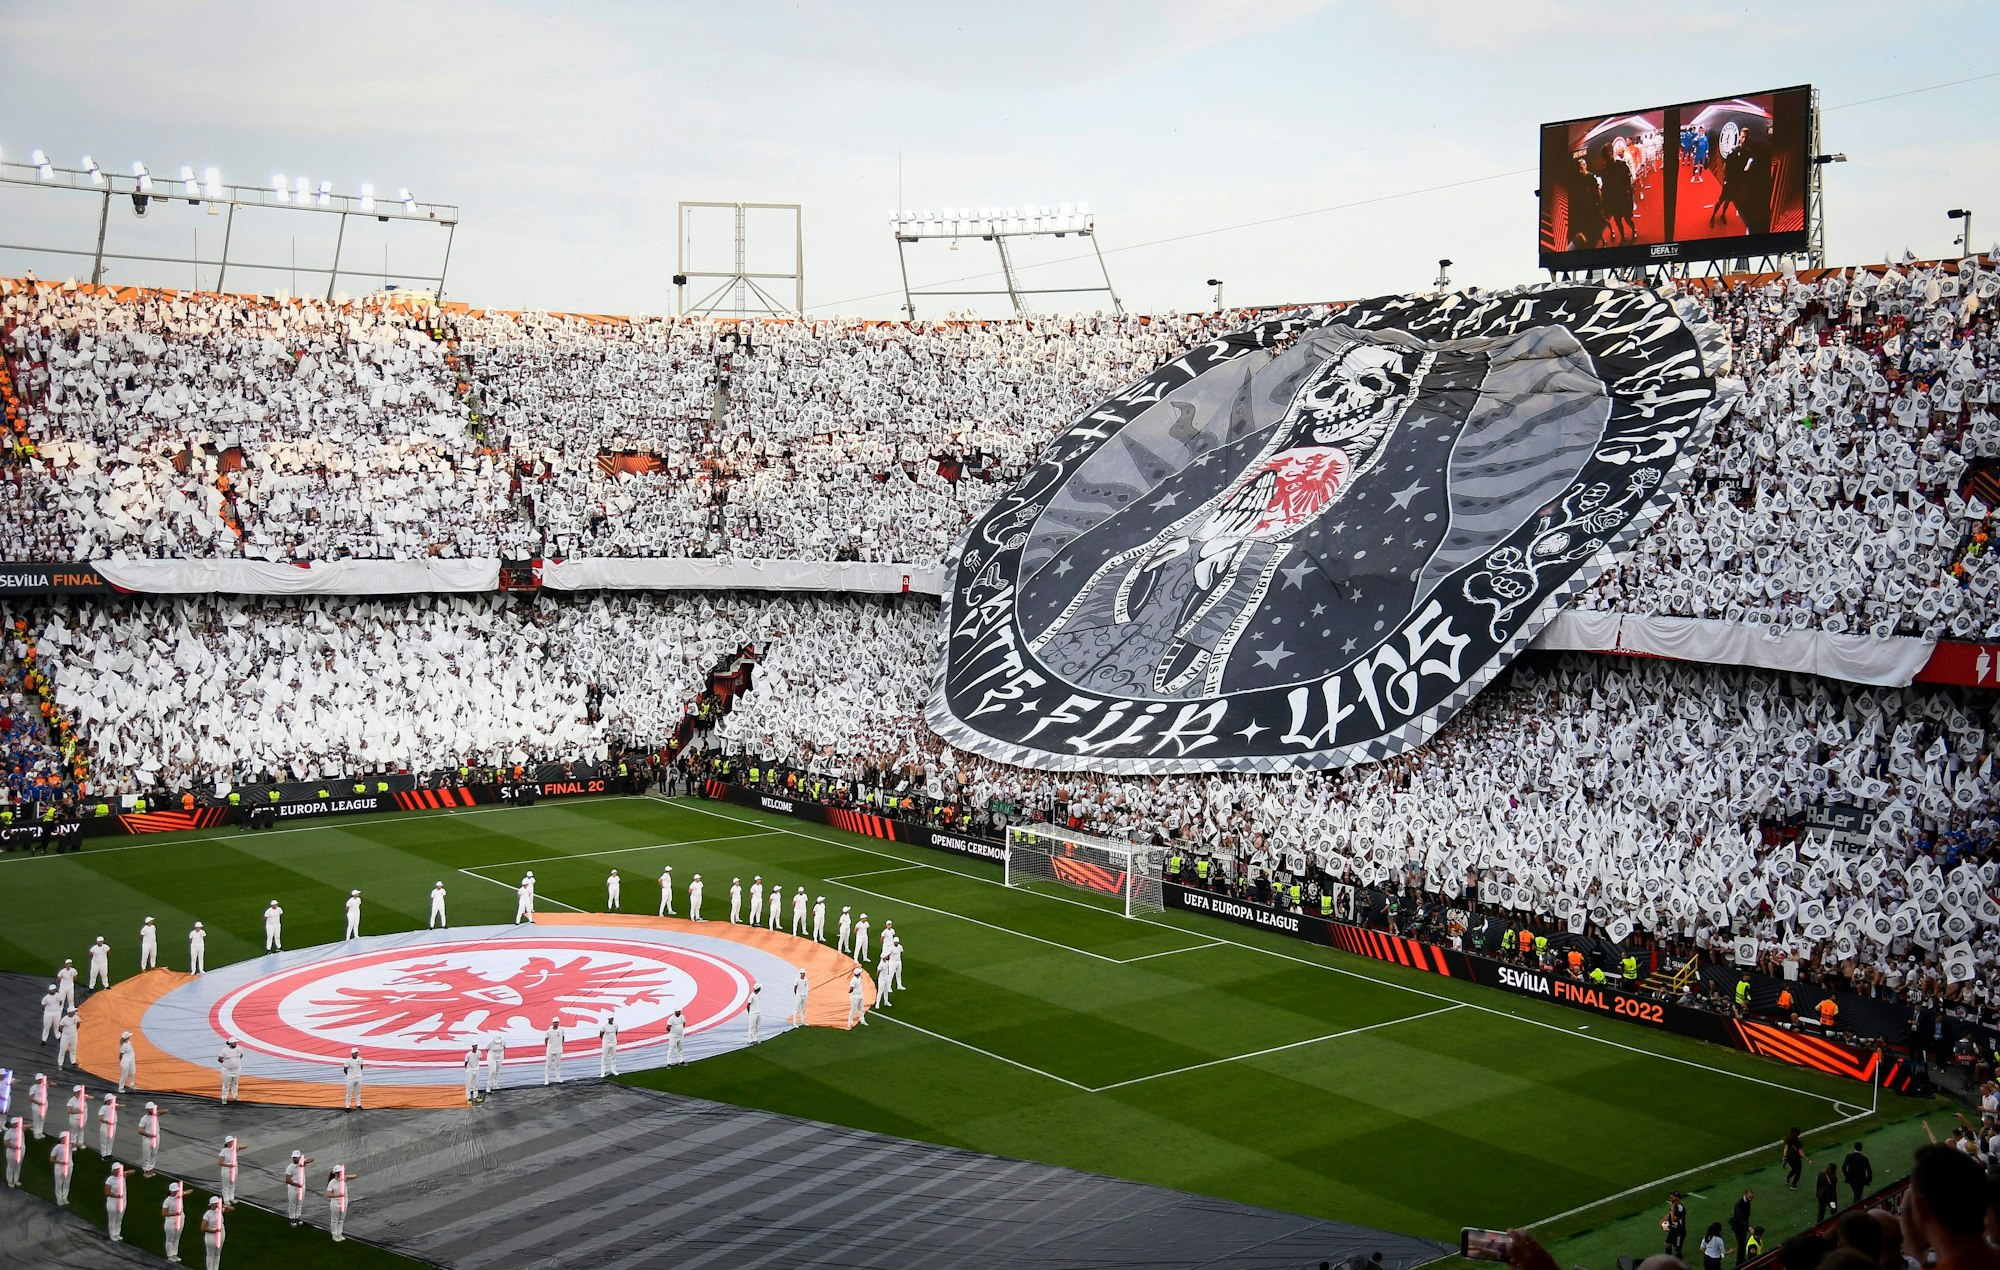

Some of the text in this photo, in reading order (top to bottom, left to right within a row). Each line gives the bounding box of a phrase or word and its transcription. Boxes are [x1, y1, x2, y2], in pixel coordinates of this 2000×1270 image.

[1650, 246, 1678, 255] UEFA.tv
[53, 573, 103, 587] FINAL
[950, 585, 1471, 757] BITTE FÜR UNS
[544, 782, 586, 796] FINAL
[280, 803, 328, 816] EUROPA
[331, 798, 378, 812] LEAGUE
[761, 796, 793, 813] WELCOME
[931, 833, 1013, 862] OPENING CEREMONY
[1183, 892, 1299, 932] UEFA EUROPA LEAGUE
[1554, 980, 1610, 1010] FINAL
[1614, 995, 1664, 1024] 2022
